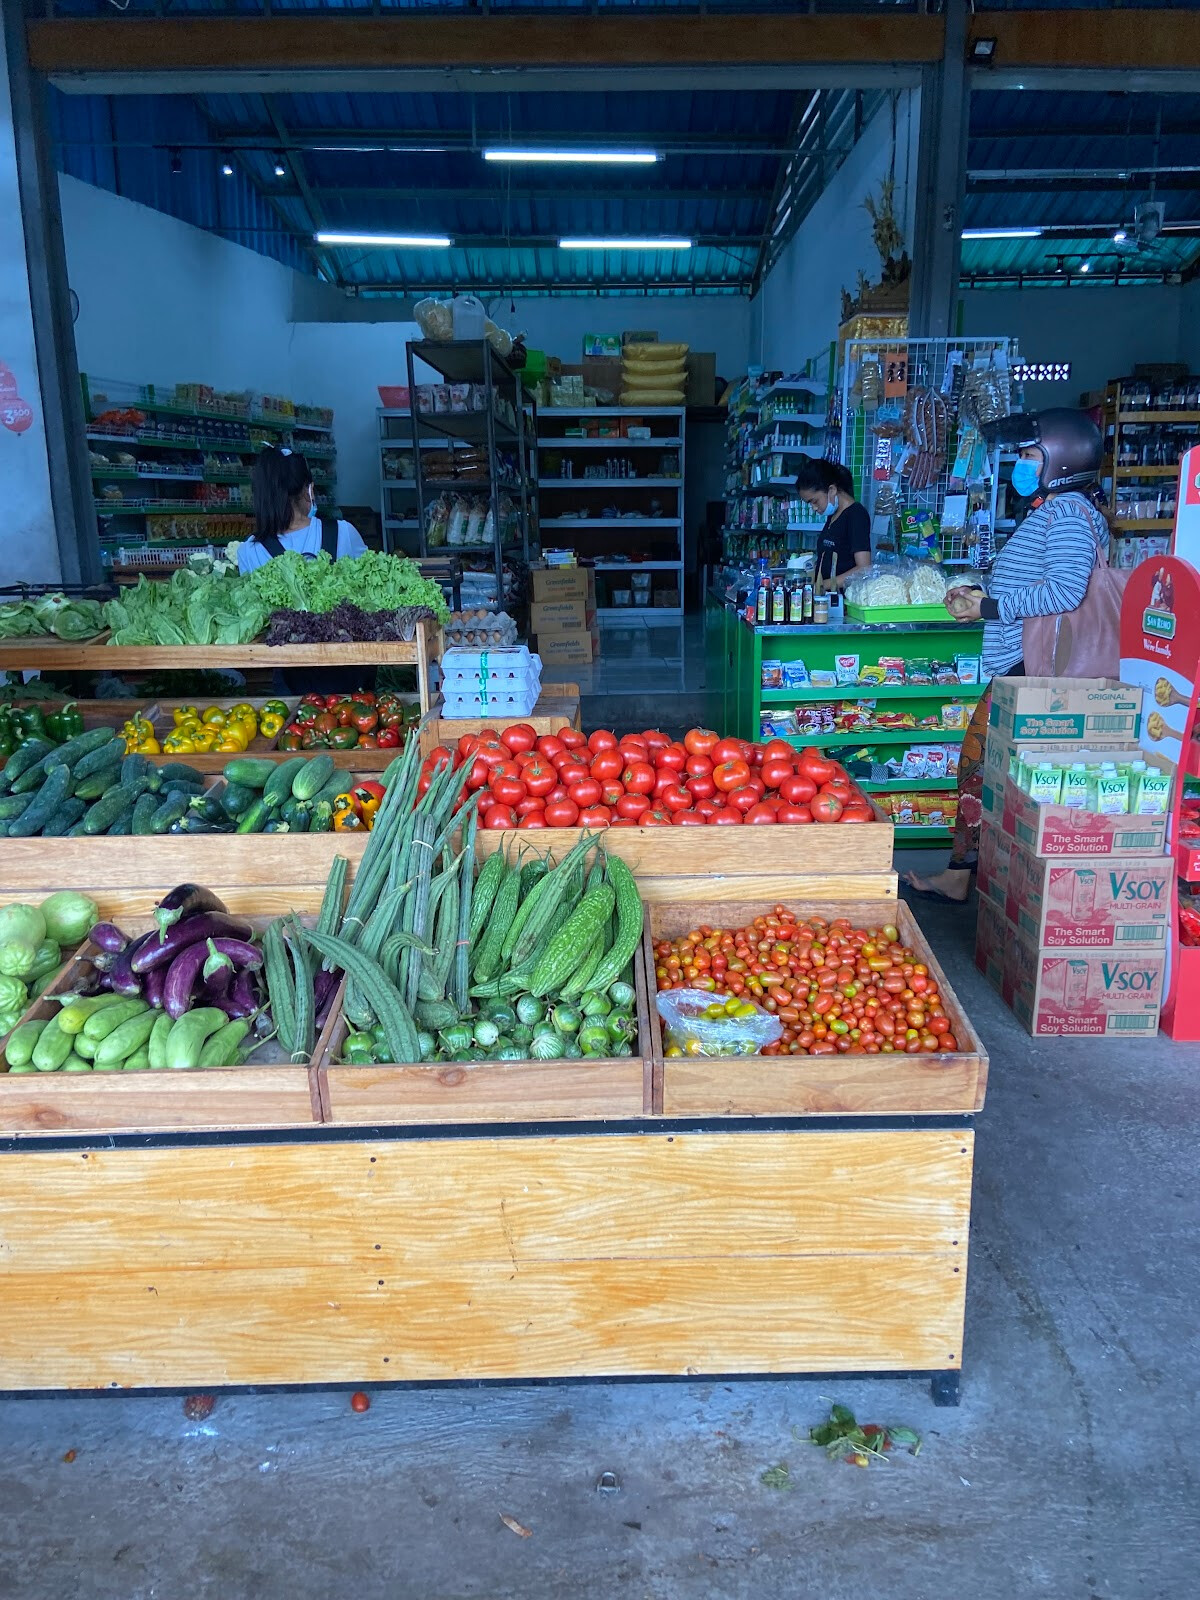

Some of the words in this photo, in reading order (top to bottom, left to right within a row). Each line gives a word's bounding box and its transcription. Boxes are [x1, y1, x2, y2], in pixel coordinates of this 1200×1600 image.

[550, 640, 580, 648] Greenfields
[1088, 693, 1127, 701] ORIGINAL
[1026, 718, 1044, 727] The
[1045, 718, 1075, 727] Smart
[1020, 727, 1039, 736] Soy
[1040, 726, 1078, 735] Solution
[1069, 773, 1087, 786] V-SO
[1052, 834, 1071, 843] The
[1073, 834, 1104, 843] Smart
[1045, 843, 1063, 852] Soy
[1066, 843, 1108, 852] Solution
[1109, 872, 1166, 900] V-SOY
[1109, 902, 1162, 910] MULTI-GRAIN
[1054, 927, 1073, 936] The
[1075, 927, 1106, 936] Smart
[1047, 936, 1066, 946] Soy
[1069, 936, 1110, 945] Solution
[1101, 962, 1158, 990] V-SOY
[1101, 992, 1153, 1000] MULTI-GRAIN
[1047, 1015, 1065, 1024] The
[1067, 1015, 1098, 1024] Smart
[1040, 1024, 1060, 1033] Soy
[1062, 1024, 1102, 1032] Solution
